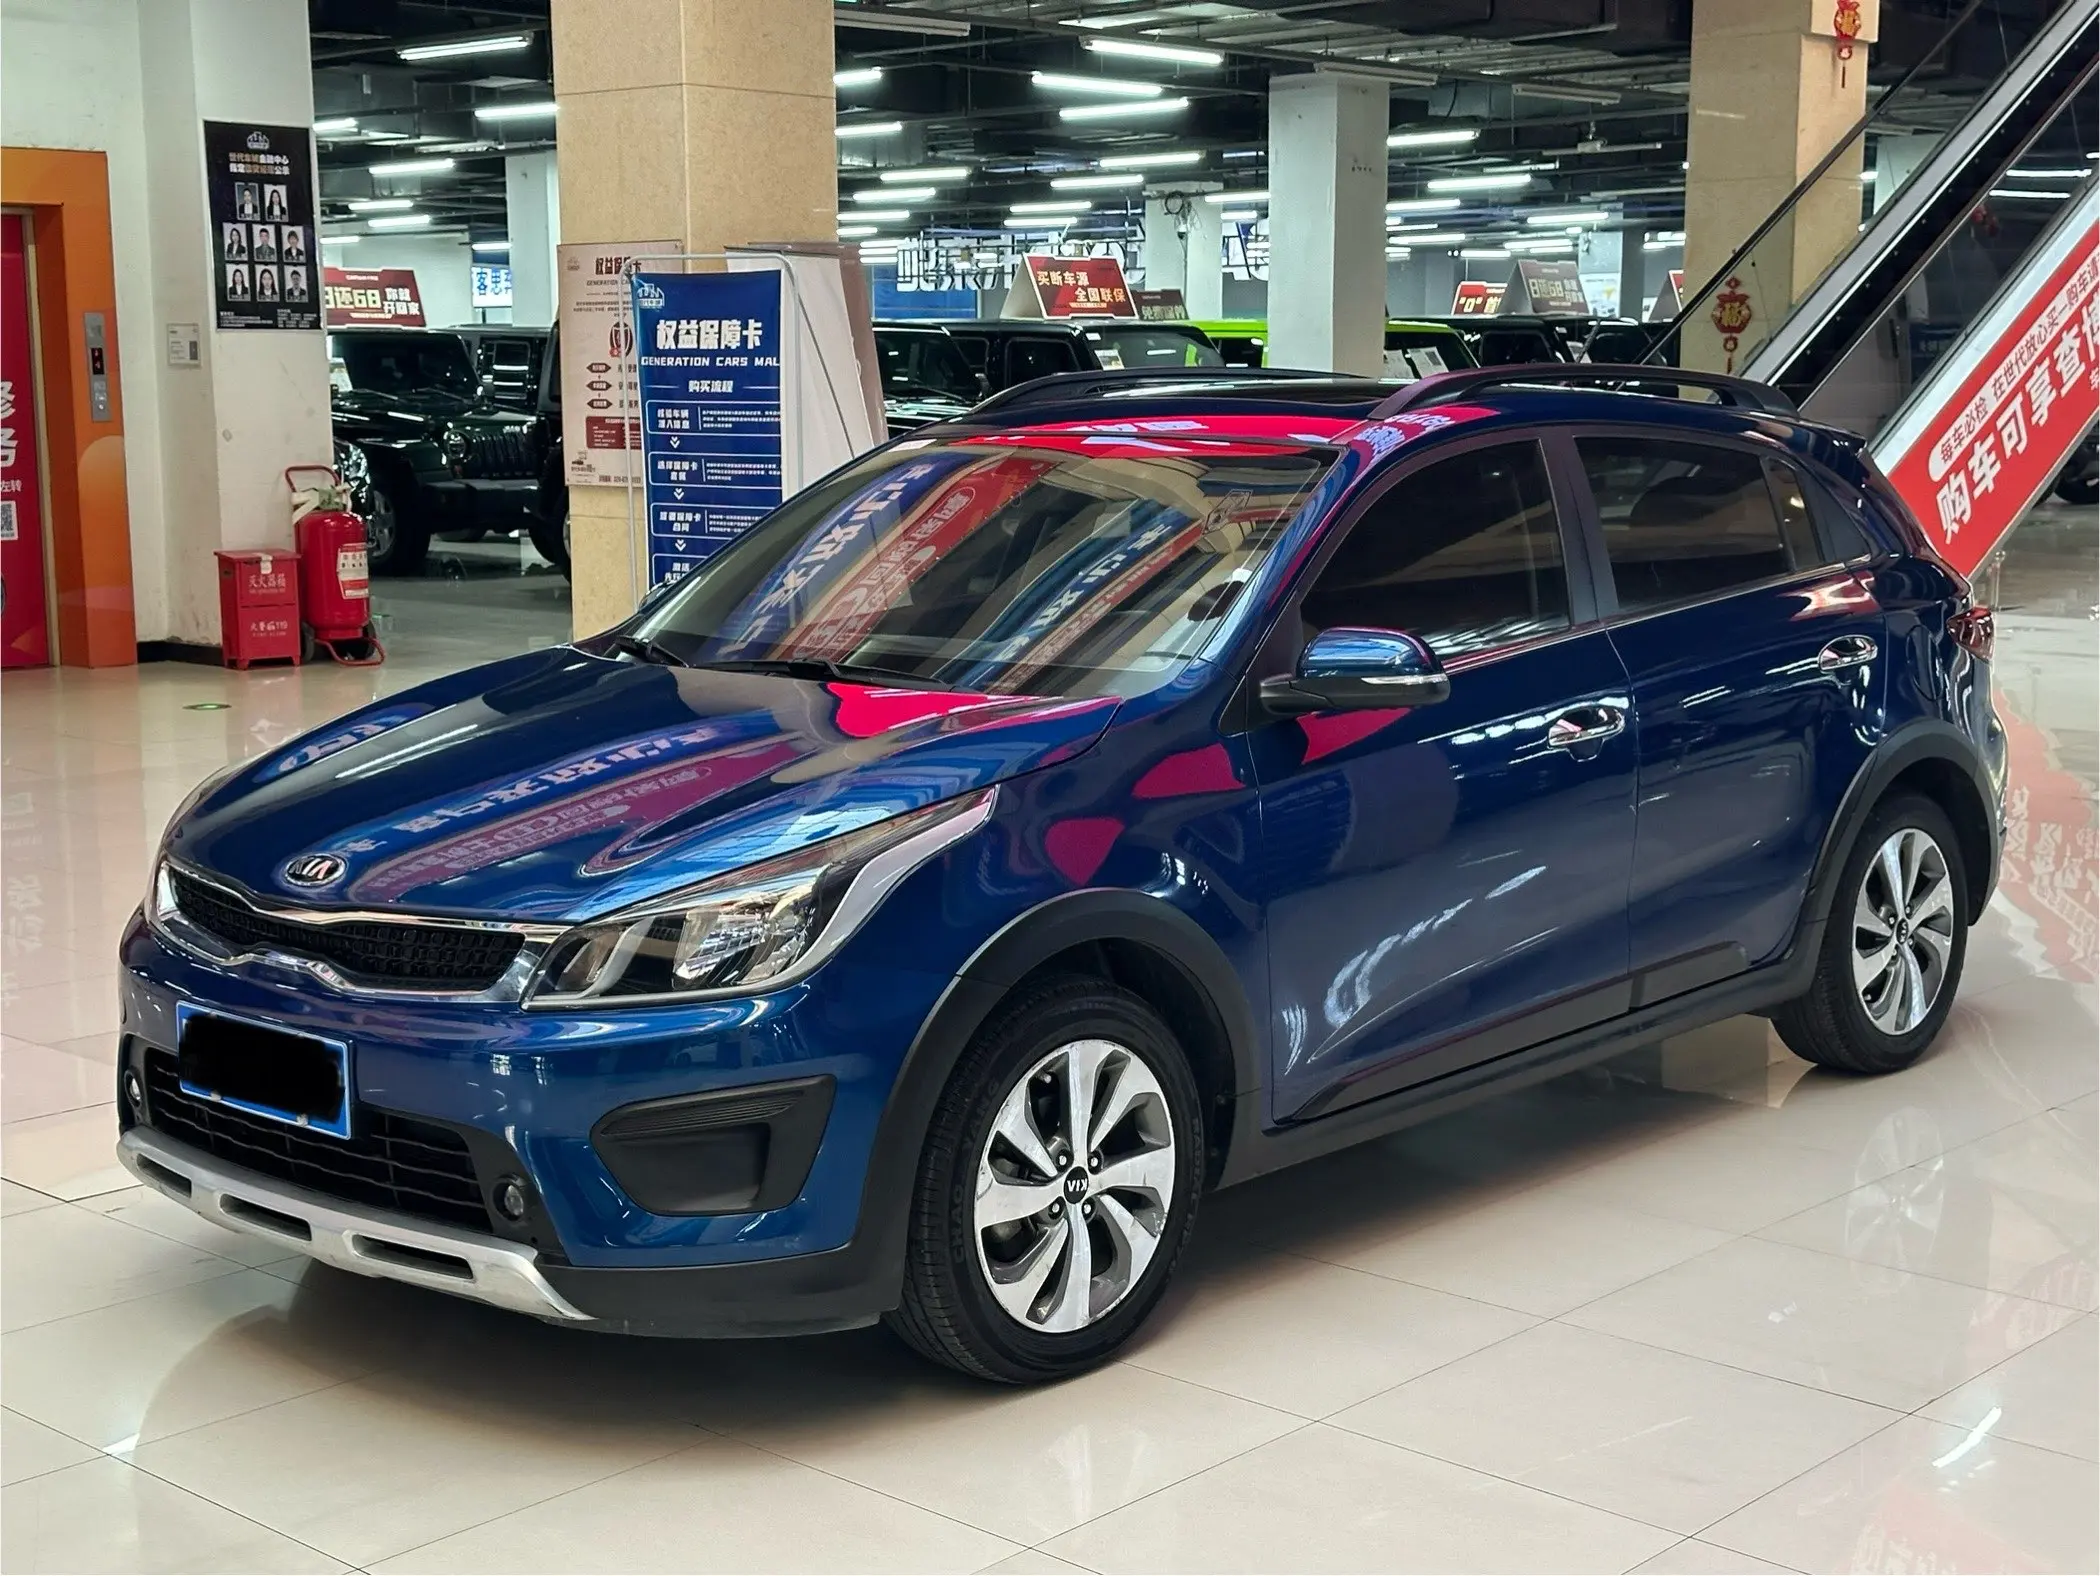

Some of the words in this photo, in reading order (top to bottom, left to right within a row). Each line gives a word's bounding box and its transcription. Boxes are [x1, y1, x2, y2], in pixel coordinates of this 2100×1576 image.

[1037, 271, 1089, 286] 买断车源
[1075, 287, 1125, 302] 全国联保
[657, 319, 762, 349] 权益保障卡
[641, 356, 710, 367] GENERATION
[716, 357, 748, 366] CARS
[688, 380, 733, 393] 购买流程
[1940, 397, 1989, 462] 每车必检
[249, 573, 286, 588] 灭火器箱
[288, 857, 333, 879] KIA
[1067, 1178, 1087, 1192] KIA
